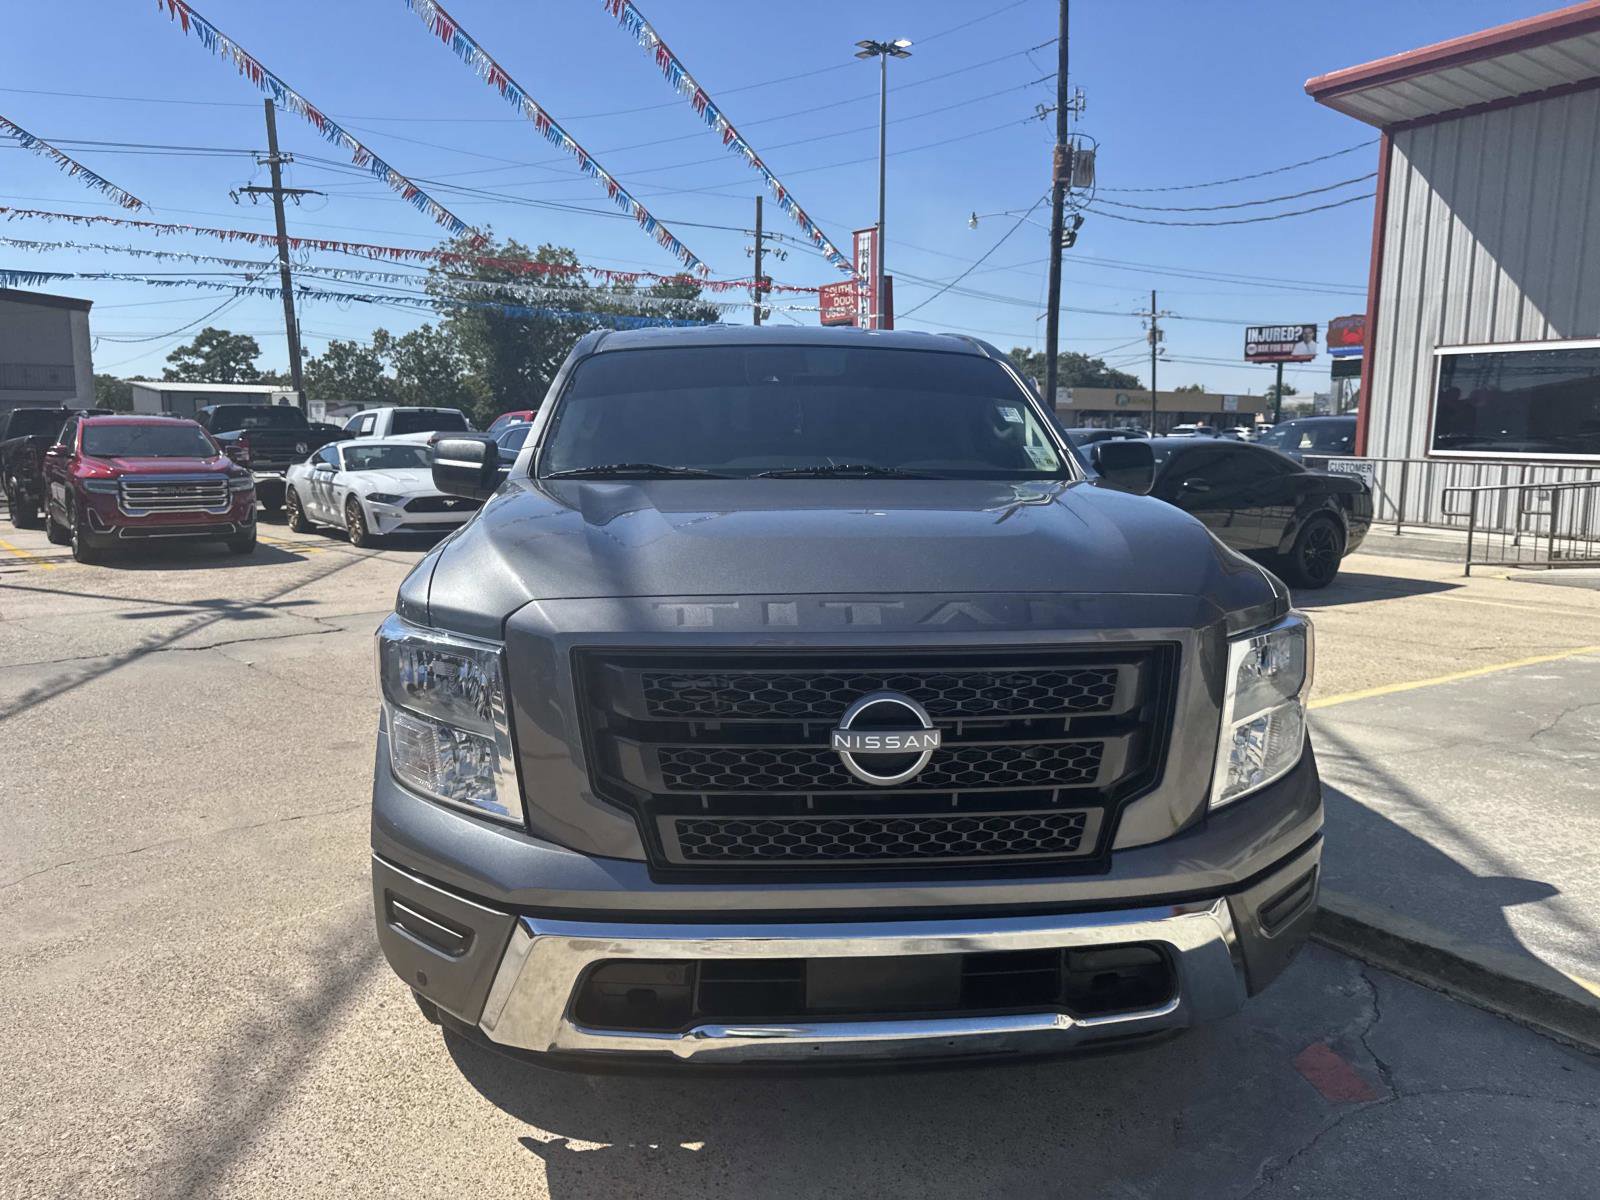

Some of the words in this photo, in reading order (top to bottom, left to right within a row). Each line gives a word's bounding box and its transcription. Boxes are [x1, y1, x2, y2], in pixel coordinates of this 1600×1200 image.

[1247, 327, 1303, 342] INJURED?
[1329, 462, 1373, 473] CUSTOMER
[834, 733, 938, 749] NISSAN
